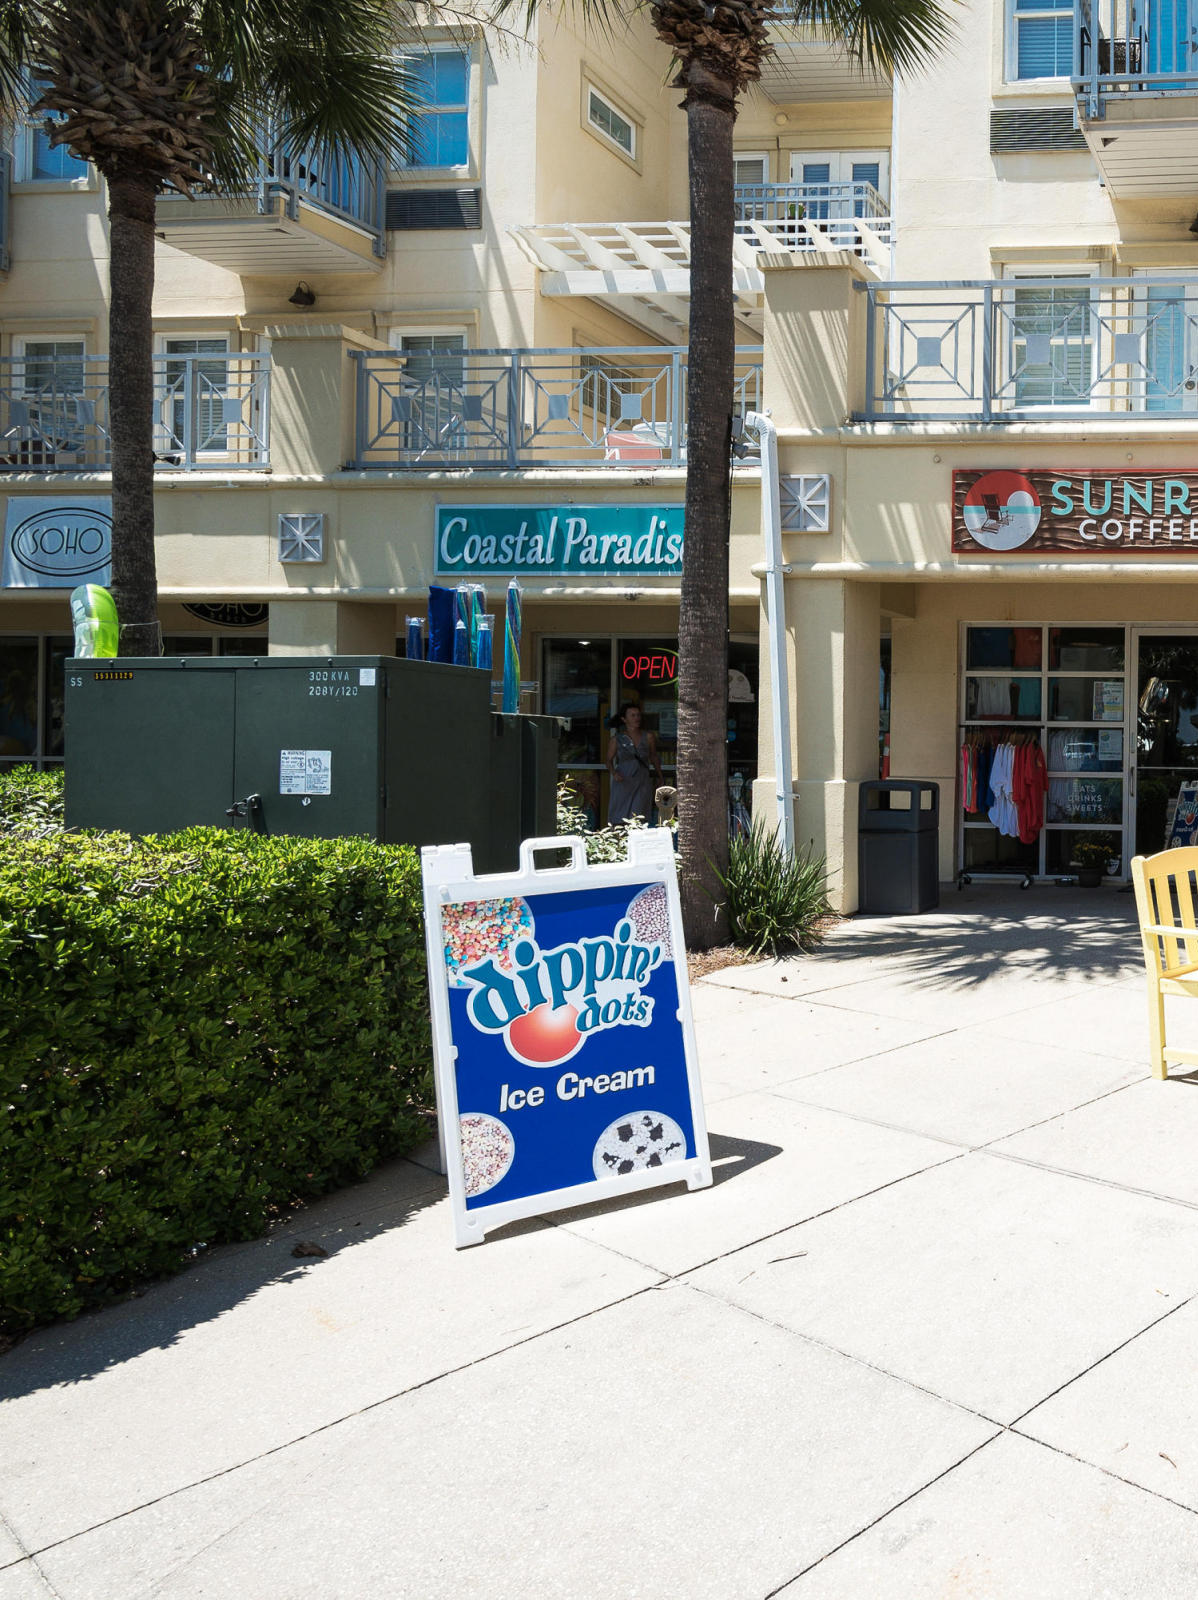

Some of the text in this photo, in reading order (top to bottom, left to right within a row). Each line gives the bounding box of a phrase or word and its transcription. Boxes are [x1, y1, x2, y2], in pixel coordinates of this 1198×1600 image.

[30, 527, 104, 555] SOHO
[440, 515, 685, 565] Coastal Paradis
[308, 671, 328, 681] 300
[331, 671, 350, 681] KVA
[622, 655, 676, 680] OPEN
[308, 686, 358, 697] 208Y/120
[462, 922, 661, 1030] dippin'
[576, 994, 650, 1033] dots
[499, 1064, 656, 1113] Ice Cream
